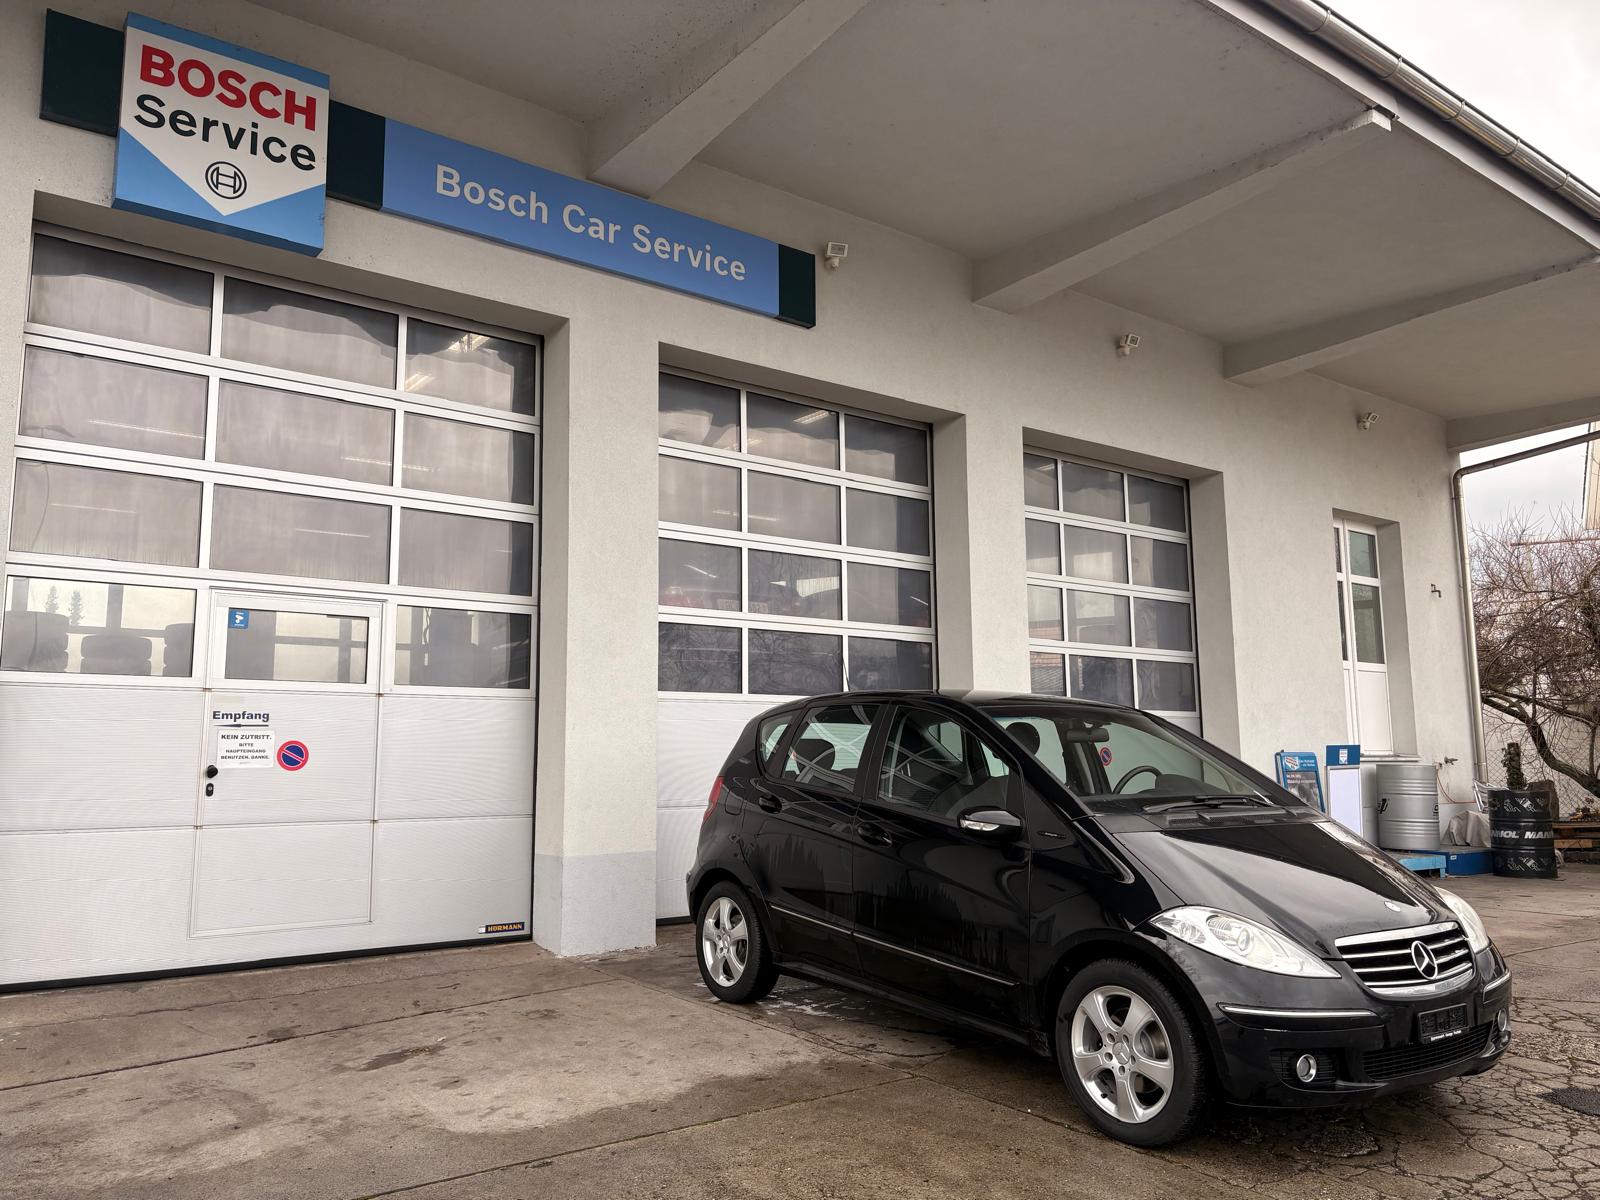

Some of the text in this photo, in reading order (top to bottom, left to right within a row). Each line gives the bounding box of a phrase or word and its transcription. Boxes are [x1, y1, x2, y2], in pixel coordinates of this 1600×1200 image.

[140, 44, 316, 131] BOSCH
[134, 94, 316, 171] Service
[436, 164, 746, 281] Bosch Car Service
[212, 711, 270, 722] Empfang
